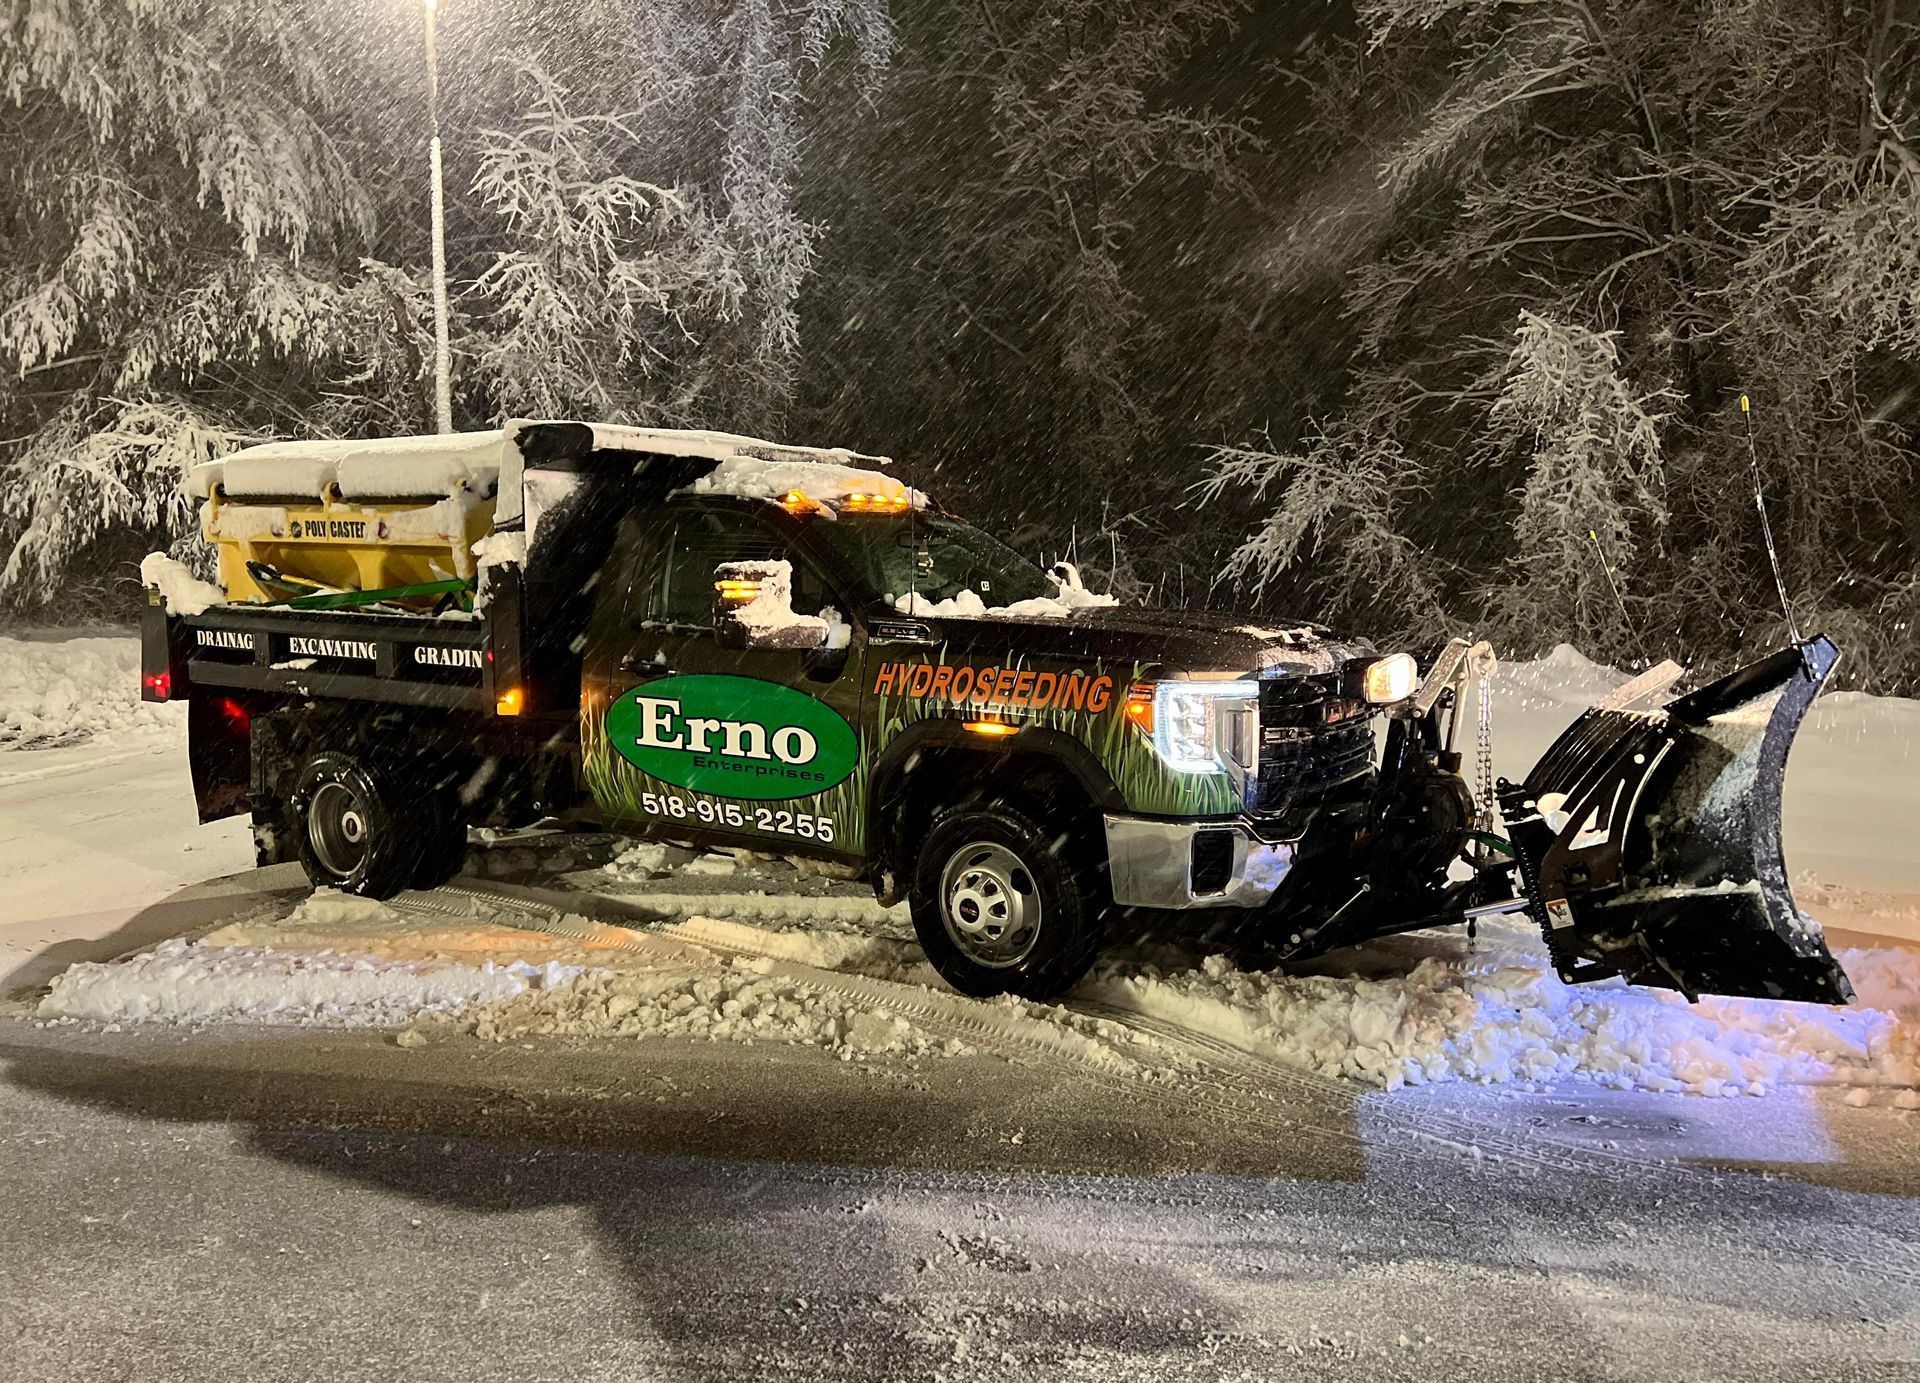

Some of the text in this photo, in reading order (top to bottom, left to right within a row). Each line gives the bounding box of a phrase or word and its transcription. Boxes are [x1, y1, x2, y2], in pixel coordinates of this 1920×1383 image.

[305, 520, 326, 537] POLY
[196, 630, 255, 650] DRAINAG
[289, 637, 377, 660] EXCAVATING
[414, 646, 483, 668] GRADIN
[873, 662, 1113, 713] HYDROSEEDING
[636, 696, 817, 765] Erno
[693, 756, 826, 782] Enterprises
[642, 792, 834, 843] 518-915-2255
